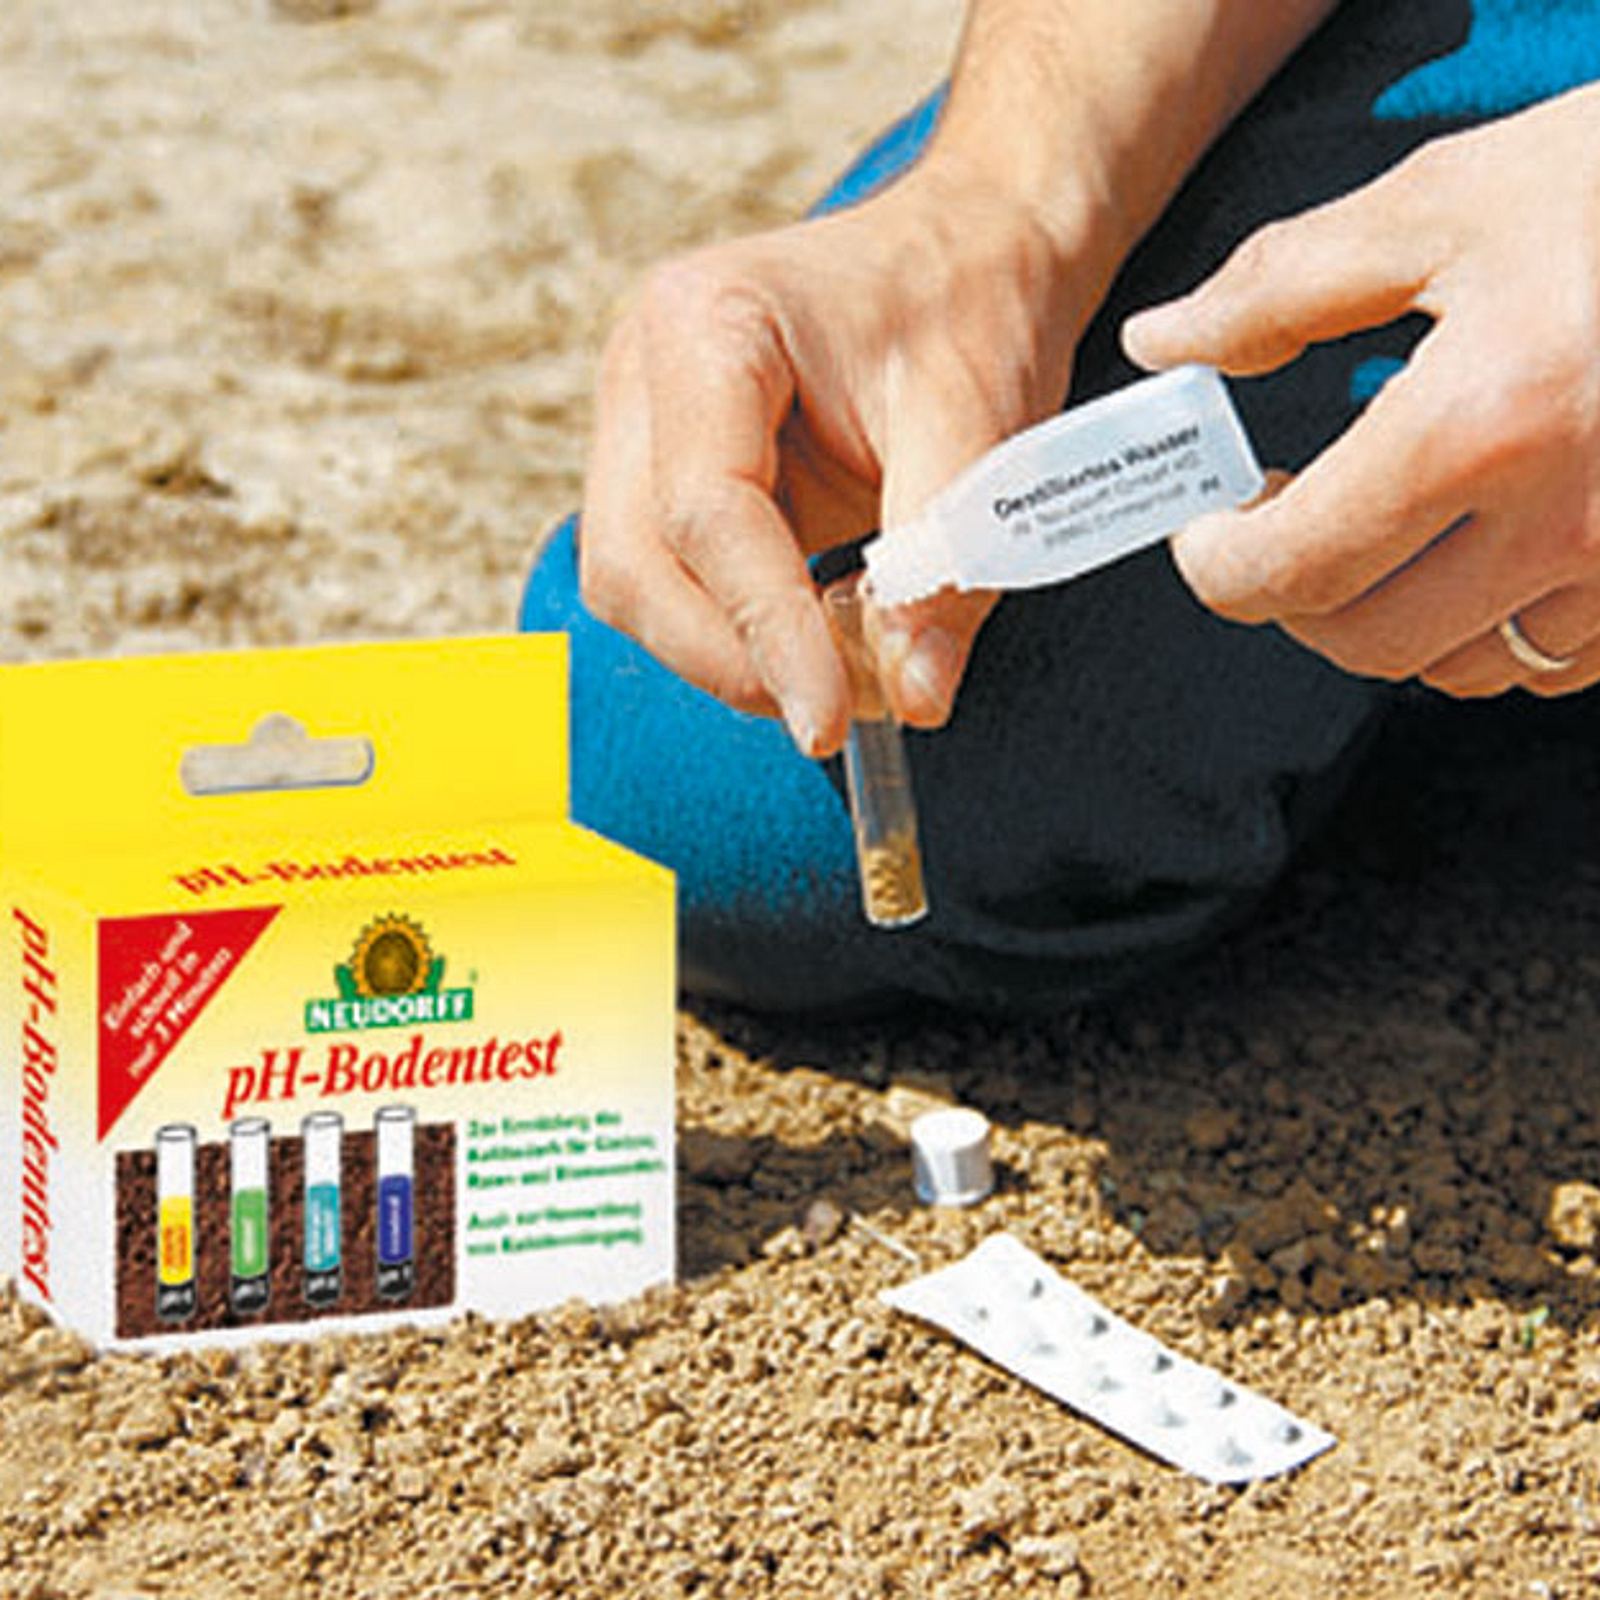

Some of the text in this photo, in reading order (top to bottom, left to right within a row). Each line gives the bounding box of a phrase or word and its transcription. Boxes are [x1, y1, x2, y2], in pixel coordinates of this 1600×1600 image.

[309, 993, 468, 1030] NEUDORFF
[13, 907, 58, 1300] pH-Bodentest
[222, 1030, 564, 1120] pH-Bodentest
